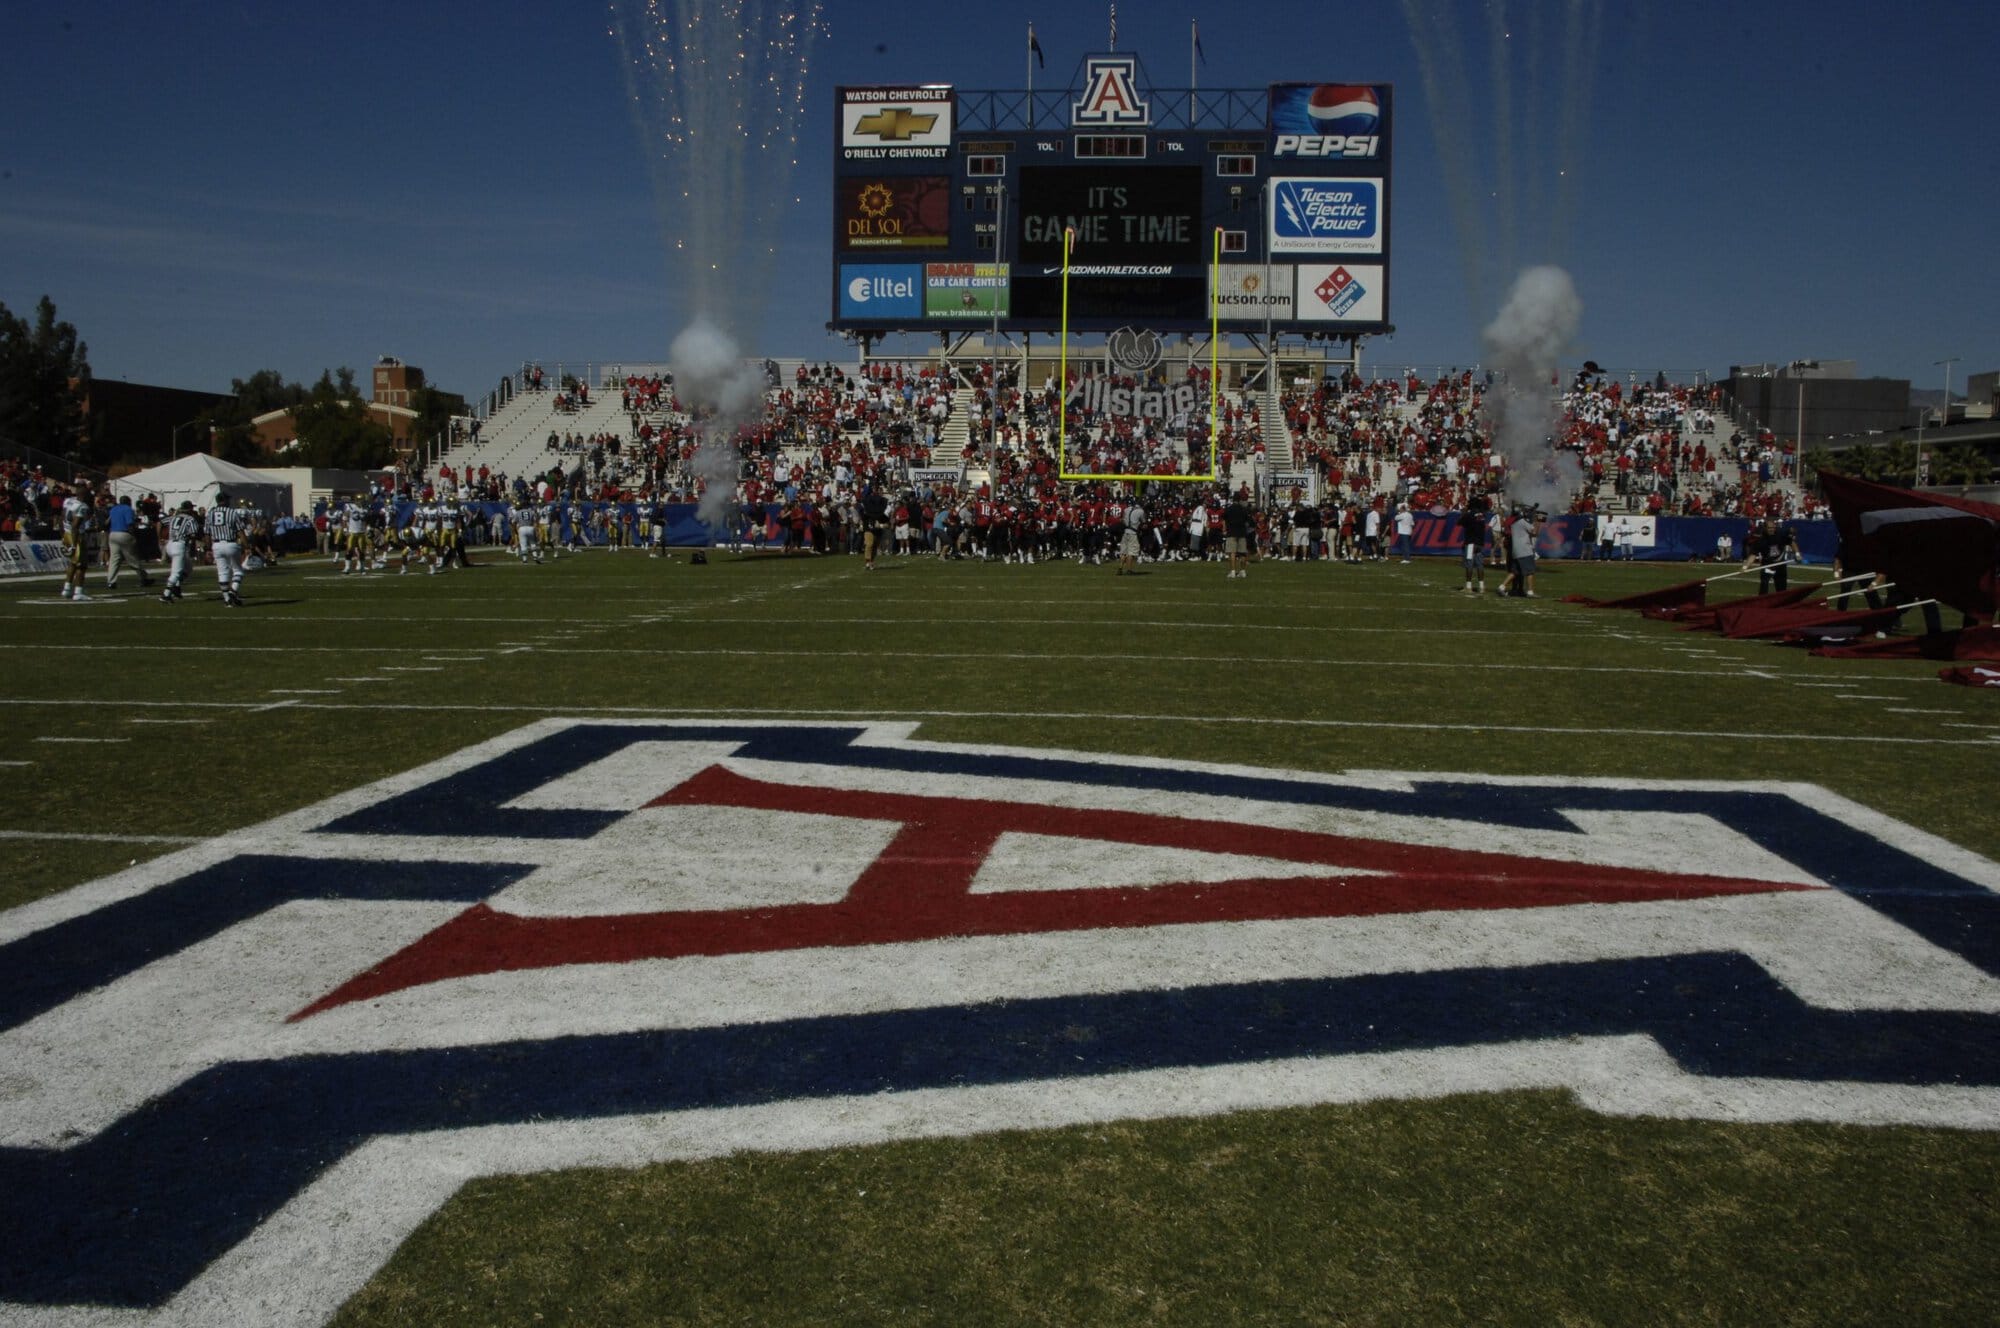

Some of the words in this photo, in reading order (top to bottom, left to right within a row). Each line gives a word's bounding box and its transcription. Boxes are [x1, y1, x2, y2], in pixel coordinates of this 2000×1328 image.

[846, 90, 886, 101] WATSON
[889, 89, 948, 101] CHEVROLET
[845, 147, 886, 159] O'RIELLY
[889, 147, 948, 158] CHEVROLET
[1037, 142, 1054, 151] TOL
[1167, 142, 1185, 152] TOL
[1273, 135, 1380, 157] PEPSI
[1088, 186, 1128, 209] IT'S
[1301, 188, 1353, 202] Tucson
[1305, 202, 1367, 216] Electric
[848, 218, 872, 235] DEL
[878, 218, 903, 235] SOL
[1024, 215, 1109, 243] GAME
[1120, 215, 1191, 243] TIME
[1311, 216, 1366, 230] Power
[1281, 240, 1316, 249] UniSource
[1318, 240, 1341, 250] Energy
[1343, 240, 1376, 250] Company
[852, 277, 914, 300] alltel
[928, 277, 946, 287] CAR
[948, 277, 969, 287] CARE
[928, 309, 1007, 318] www.brakemax.cm
[214, 511, 225, 526] B
